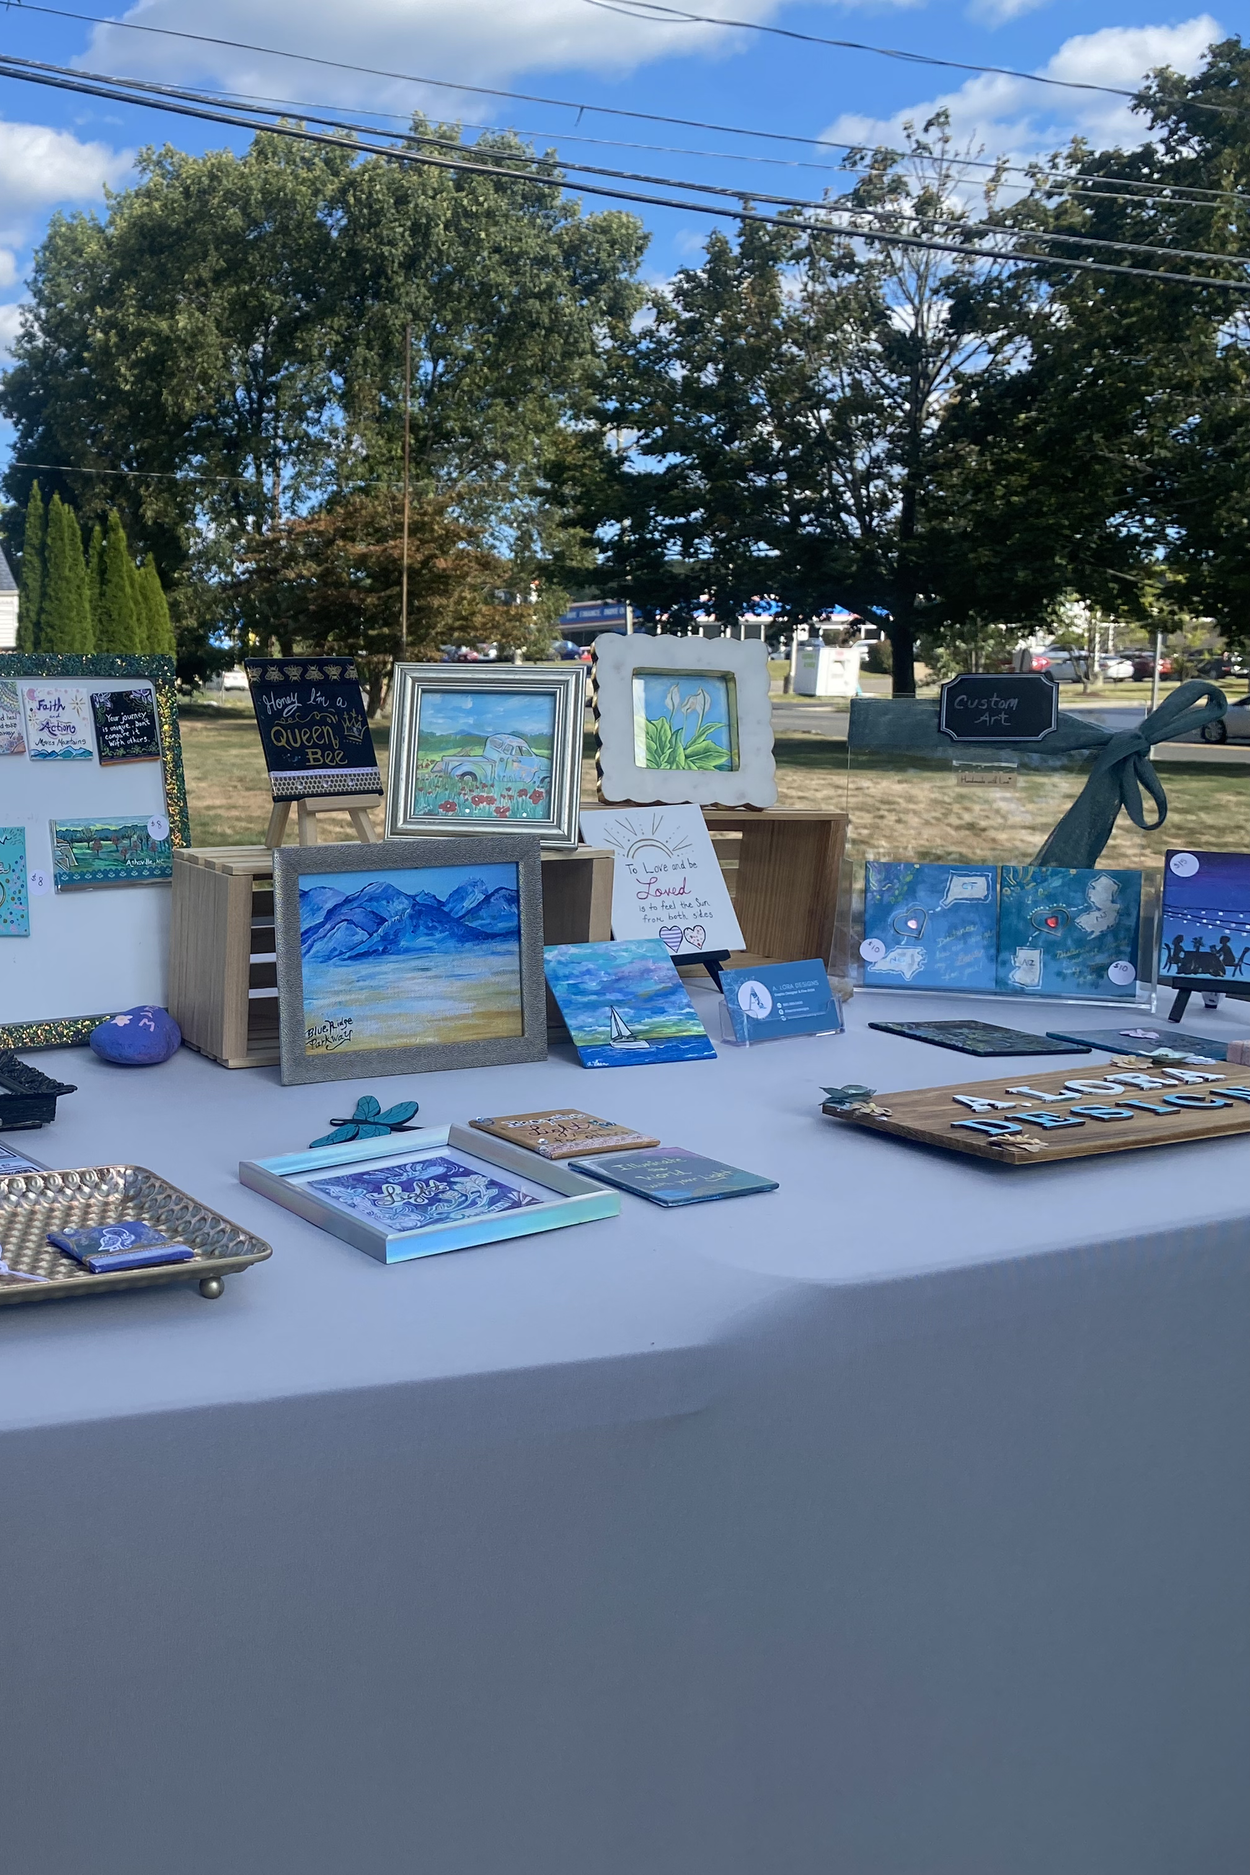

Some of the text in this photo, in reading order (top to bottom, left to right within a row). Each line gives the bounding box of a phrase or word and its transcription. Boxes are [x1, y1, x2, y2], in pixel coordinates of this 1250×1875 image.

[36, 696, 66, 712] Faith
[262, 690, 303, 717] Honey
[336, 696, 347, 708] a
[974, 711, 1011, 726] Art
[271, 725, 339, 750] Queen
[305, 749, 348, 766] Bee
[625, 857, 698, 875] To Love and be
[635, 876, 692, 900] Loved
[648, 902, 658, 911] to
[660, 900, 676, 911] feel
[679, 900, 694, 909] the
[667, 911, 688, 921] both
[304, 1025, 329, 1040] Blue
[1005, 1067, 1227, 1104] LORA
[368, 1180, 449, 1207] Light
